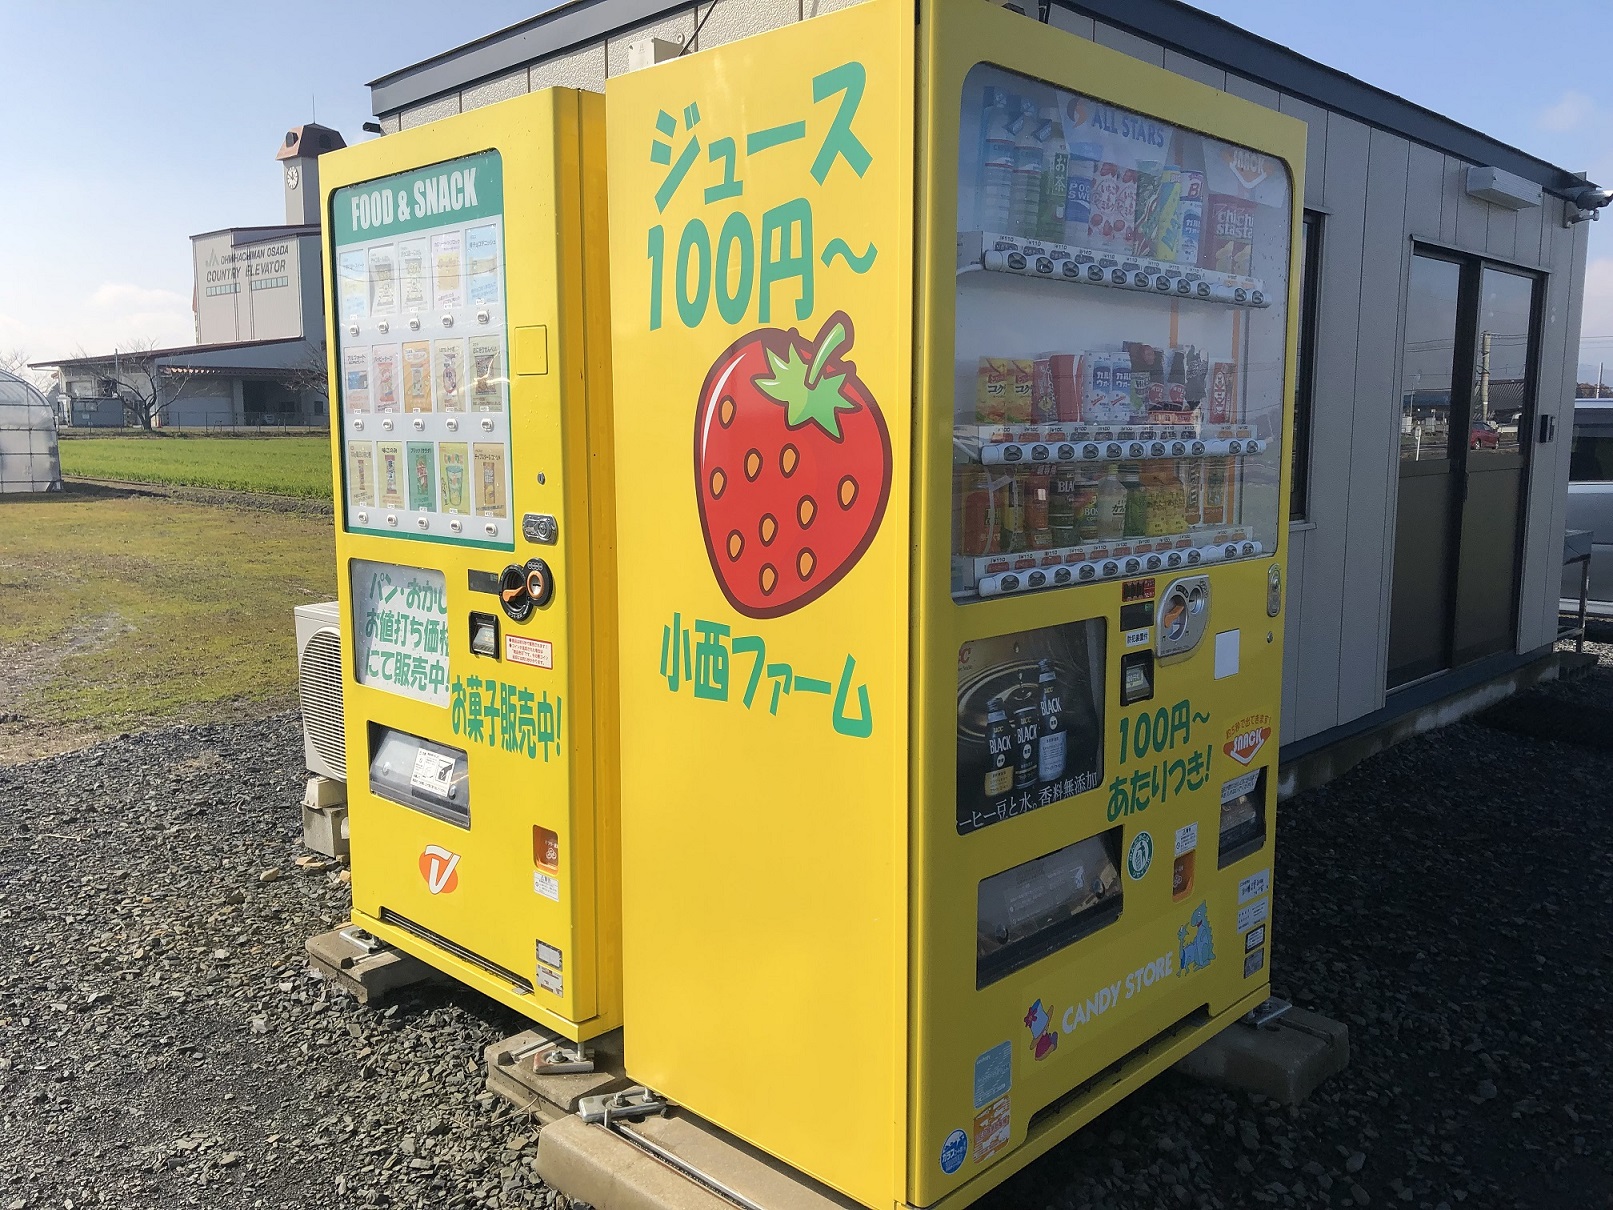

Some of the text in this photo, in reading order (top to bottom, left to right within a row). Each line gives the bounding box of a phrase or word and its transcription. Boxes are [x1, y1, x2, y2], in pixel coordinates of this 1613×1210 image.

[650, 61, 873, 215] ジュース
[1092, 105, 1164, 148] ALL STARS
[351, 167, 479, 231] FOOD & SNACK
[1055, 155, 1066, 192] お茶
[206, 259, 286, 283] COUNTRY ELEVATOR
[647, 197, 878, 331] 100円〜
[660, 611, 873, 738] 小西ファーム
[1040, 697, 1062, 716] BLACK
[452, 674, 562, 763] お菓子販売中!
[989, 735, 1012, 754] BLACK
[1016, 724, 1037, 744] BLACK
[1120, 699, 1210, 765] 100円〜
[1233, 728, 1263, 753] SNACK
[1107, 744, 1213, 822] あたりつき!
[1062, 951, 1174, 1035] CANDY STORE
